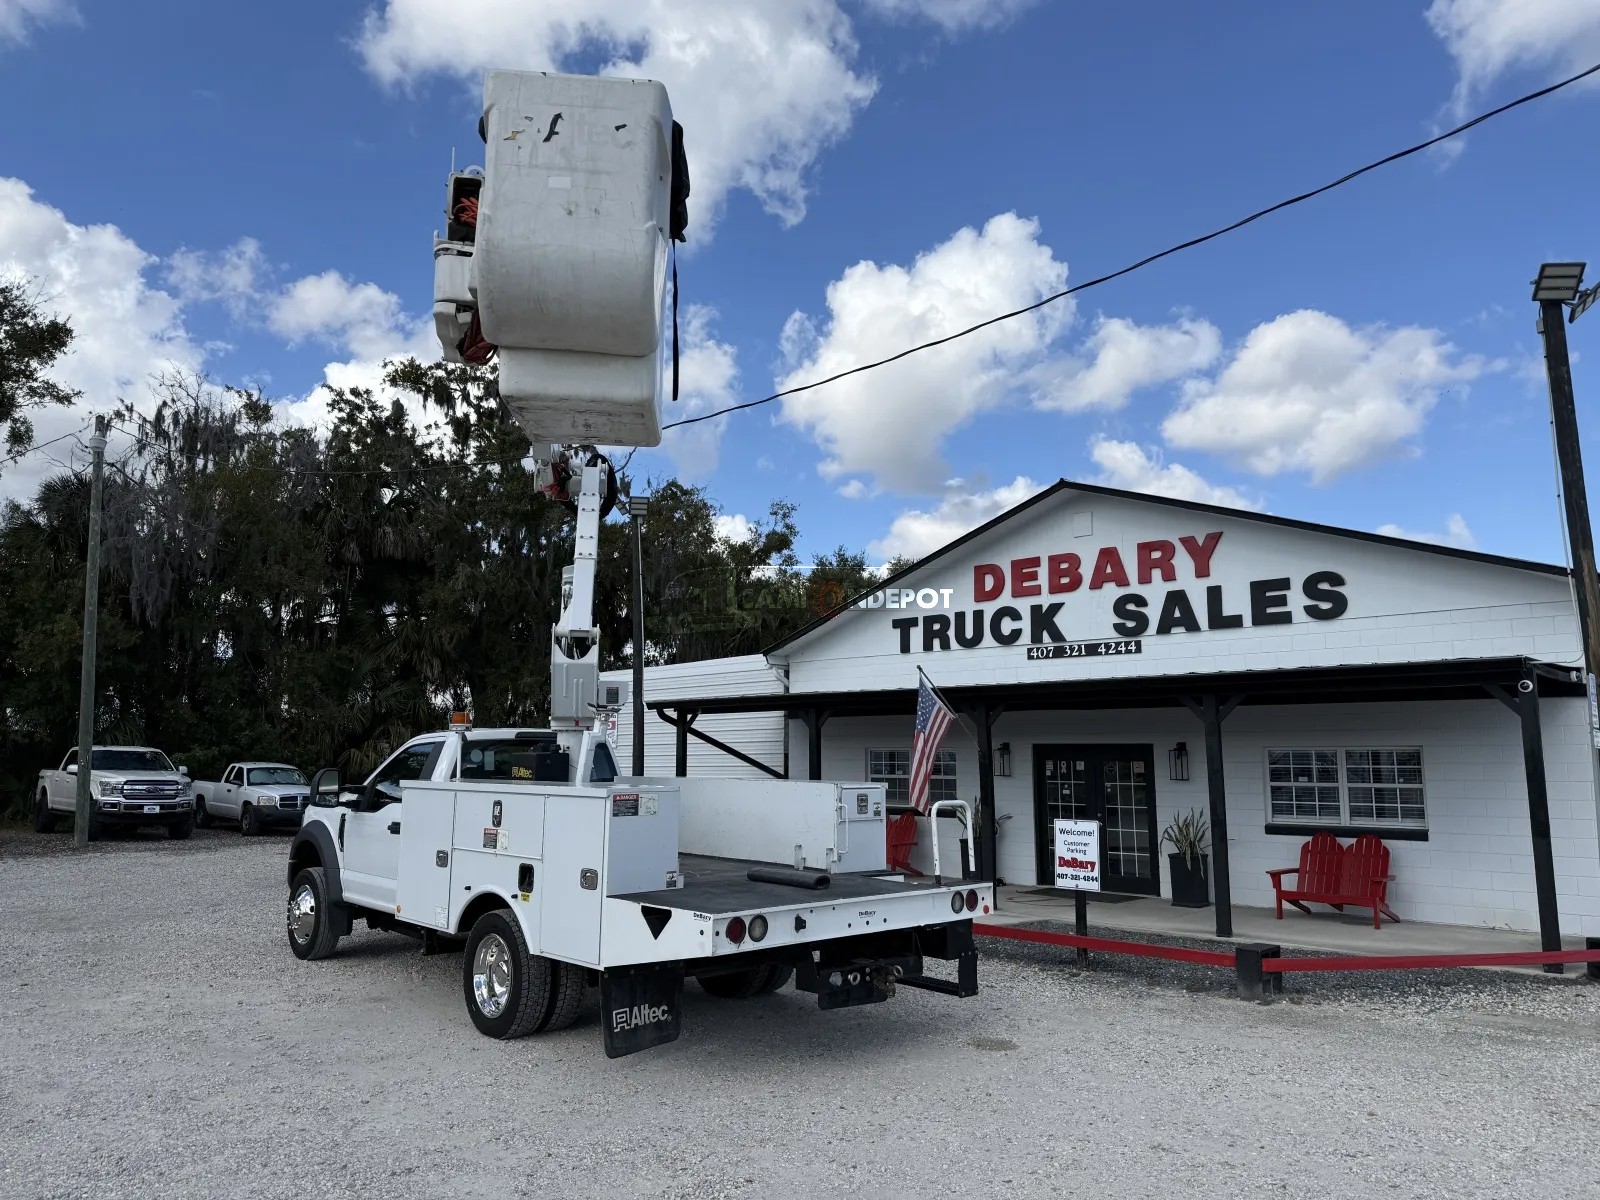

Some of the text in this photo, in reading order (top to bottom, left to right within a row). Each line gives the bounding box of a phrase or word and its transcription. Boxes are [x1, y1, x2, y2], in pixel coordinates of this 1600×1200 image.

[974, 531, 1224, 603] DEBARY
[892, 571, 1349, 653] TRUCK SALES
[1030, 640, 1137, 659] 407 321 4244
[1058, 828, 1095, 837] Welcome!
[1058, 856, 1096, 872] DeBary
[1057, 873, 1098, 882] 407-321-4244
[630, 1003, 669, 1028] Altec
